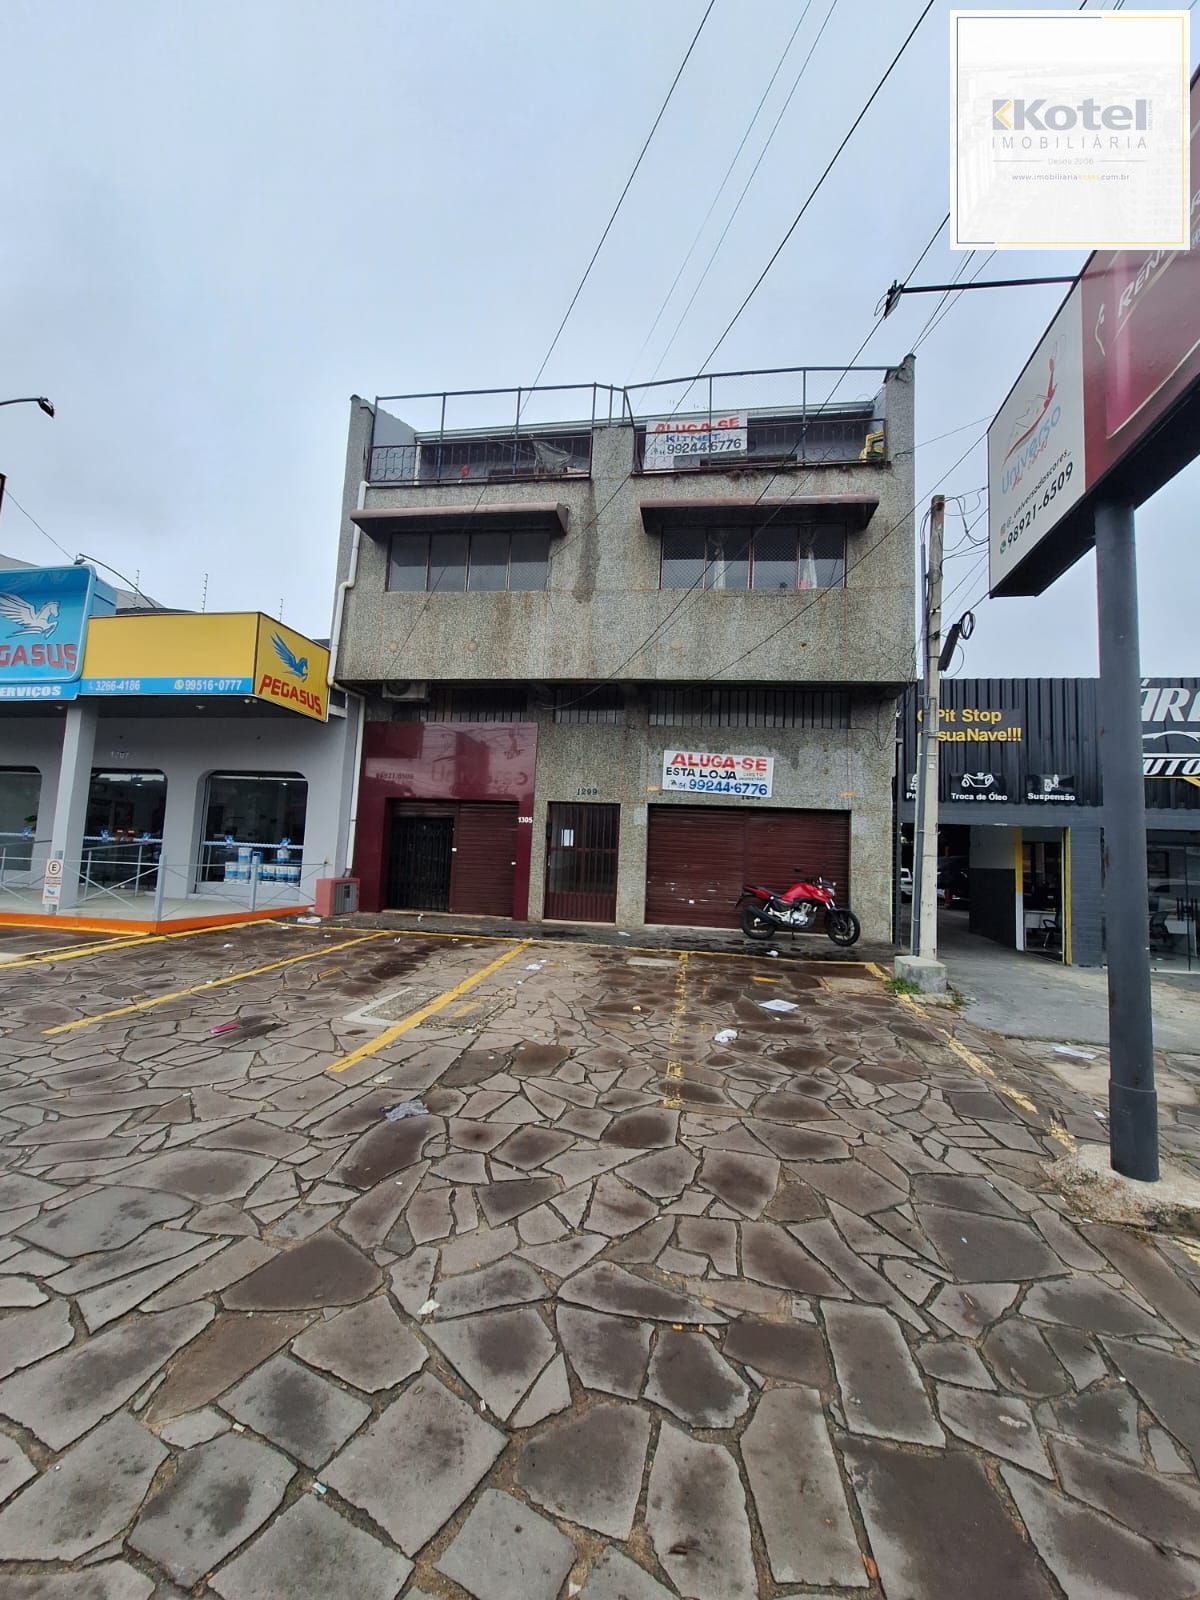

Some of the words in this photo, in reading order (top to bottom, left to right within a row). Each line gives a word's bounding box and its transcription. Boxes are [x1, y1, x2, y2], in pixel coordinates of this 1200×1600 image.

[1001, 405, 1061, 494] Universo
[1007, 461, 1074, 548] 98921-6509
[258, 674, 322, 716] PEGASUS
[961, 709, 1002, 724] Stop
[671, 753, 767, 771] ALUGA-SE
[1143, 759, 1200, 775] UTO
[666, 767, 695, 777] ESTA
[700, 769, 737, 780] LOJA
[1028, 793, 1075, 801] Suspensão
